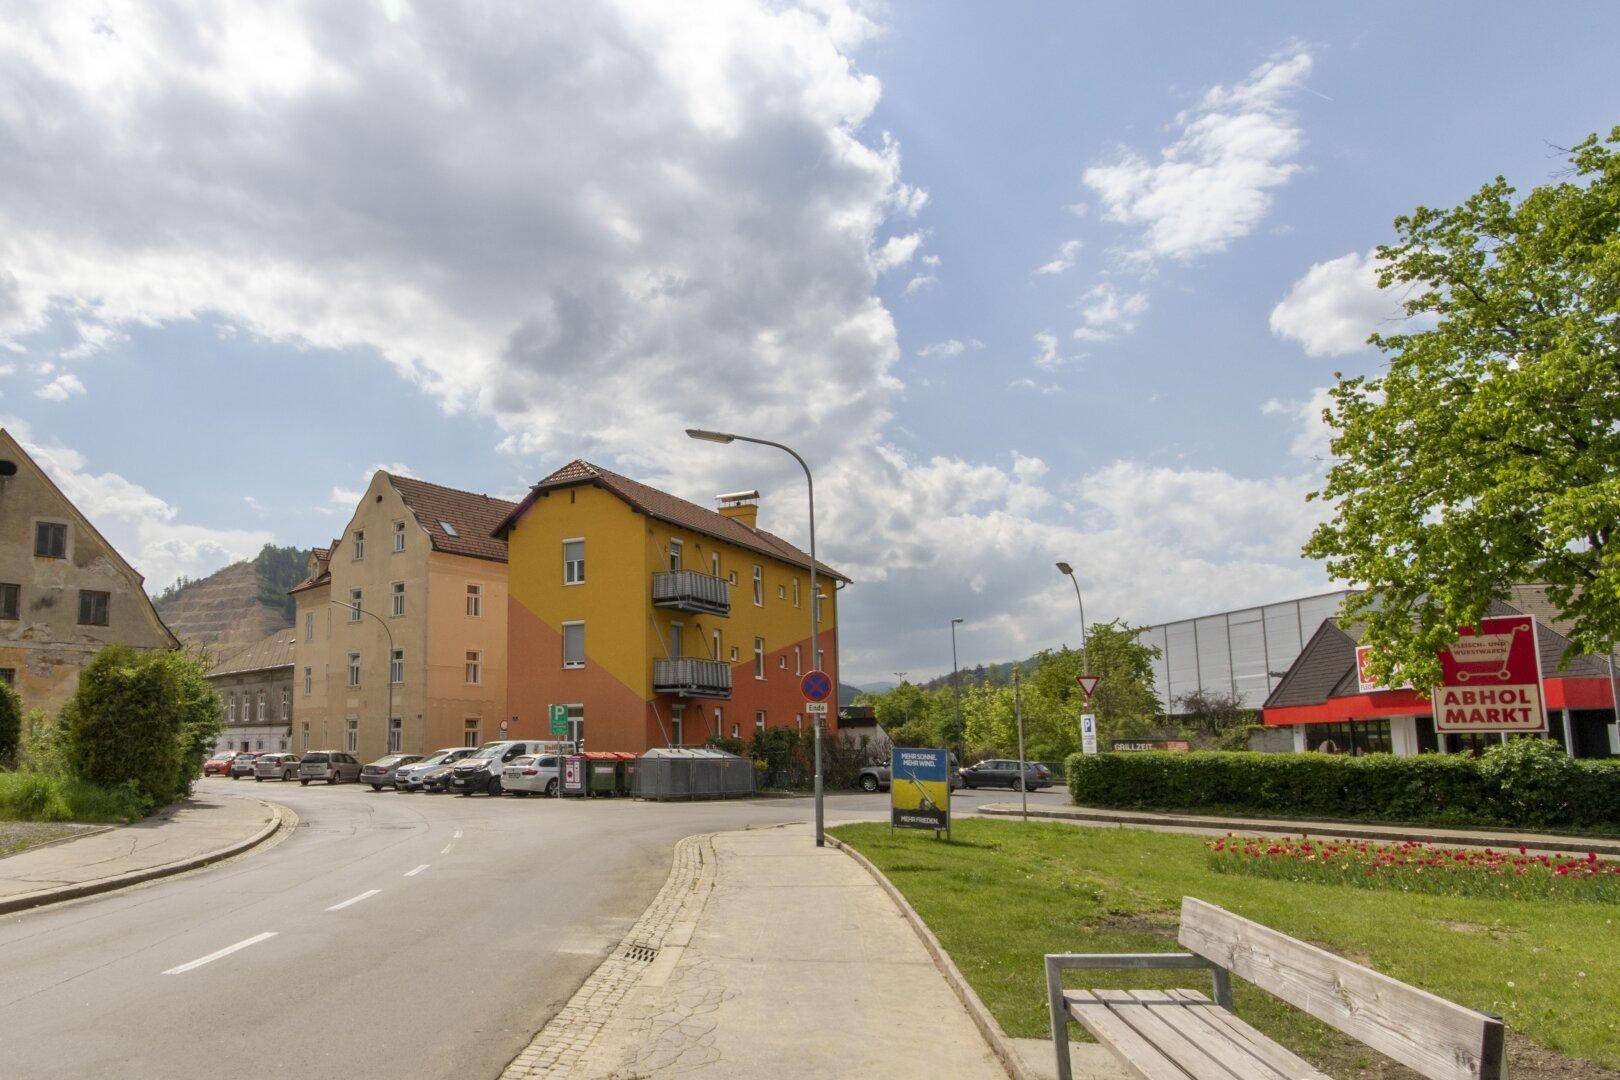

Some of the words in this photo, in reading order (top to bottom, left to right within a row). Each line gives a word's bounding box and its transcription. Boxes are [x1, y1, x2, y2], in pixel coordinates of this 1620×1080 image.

[1444, 688, 1531, 705] ABHOL
[555, 706, 565, 720] P
[1445, 707, 1532, 723] MARKT
[1114, 743, 1153, 751] GRILLZEIT
